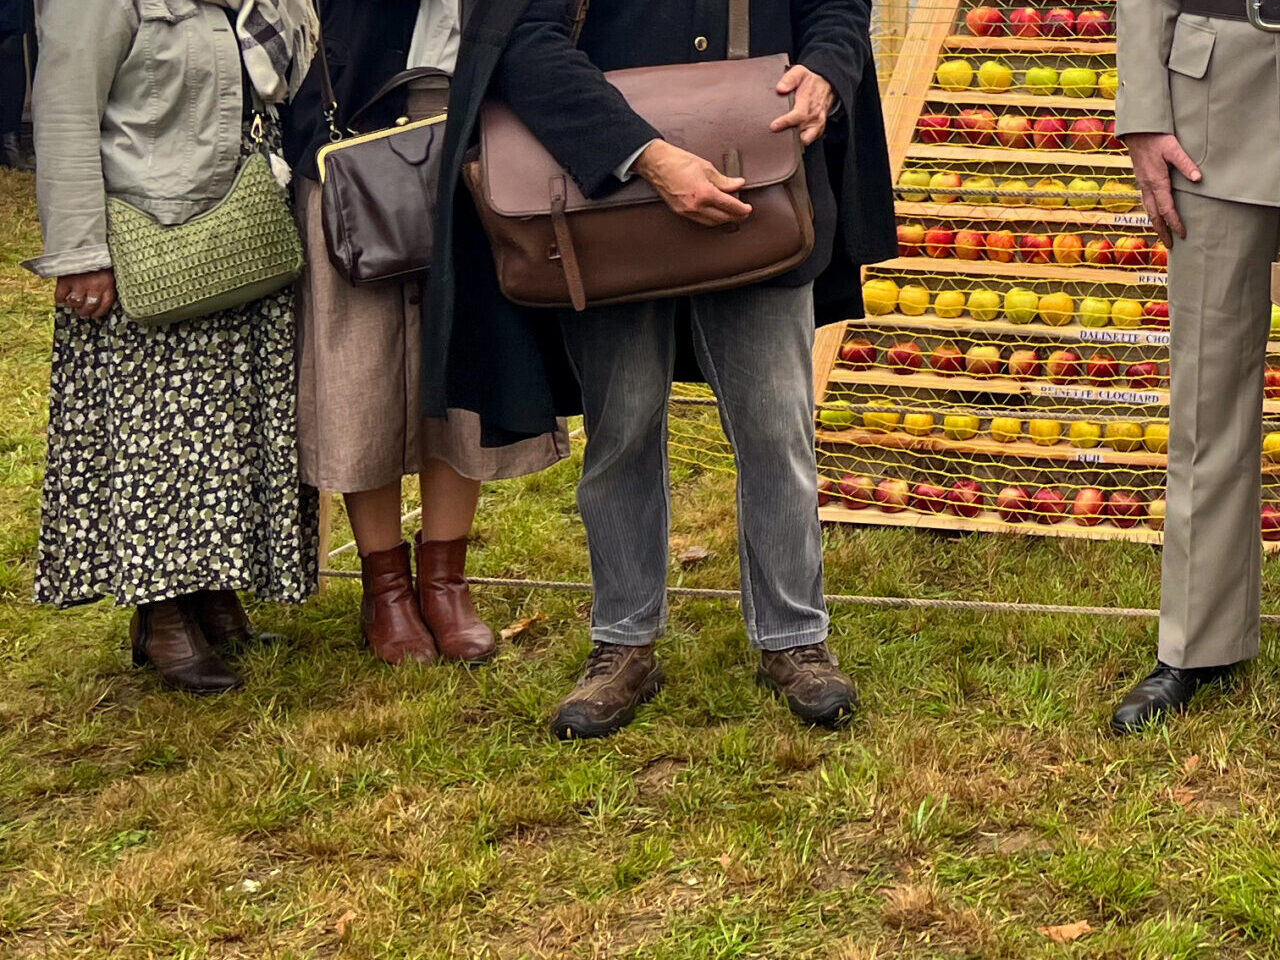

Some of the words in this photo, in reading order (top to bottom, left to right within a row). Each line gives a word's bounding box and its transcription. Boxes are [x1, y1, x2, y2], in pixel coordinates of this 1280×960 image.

[1080, 330, 1138, 342] DALINETTE
[1040, 386, 1093, 398] REINETTE
[1098, 391, 1160, 403] CLOCHARD
